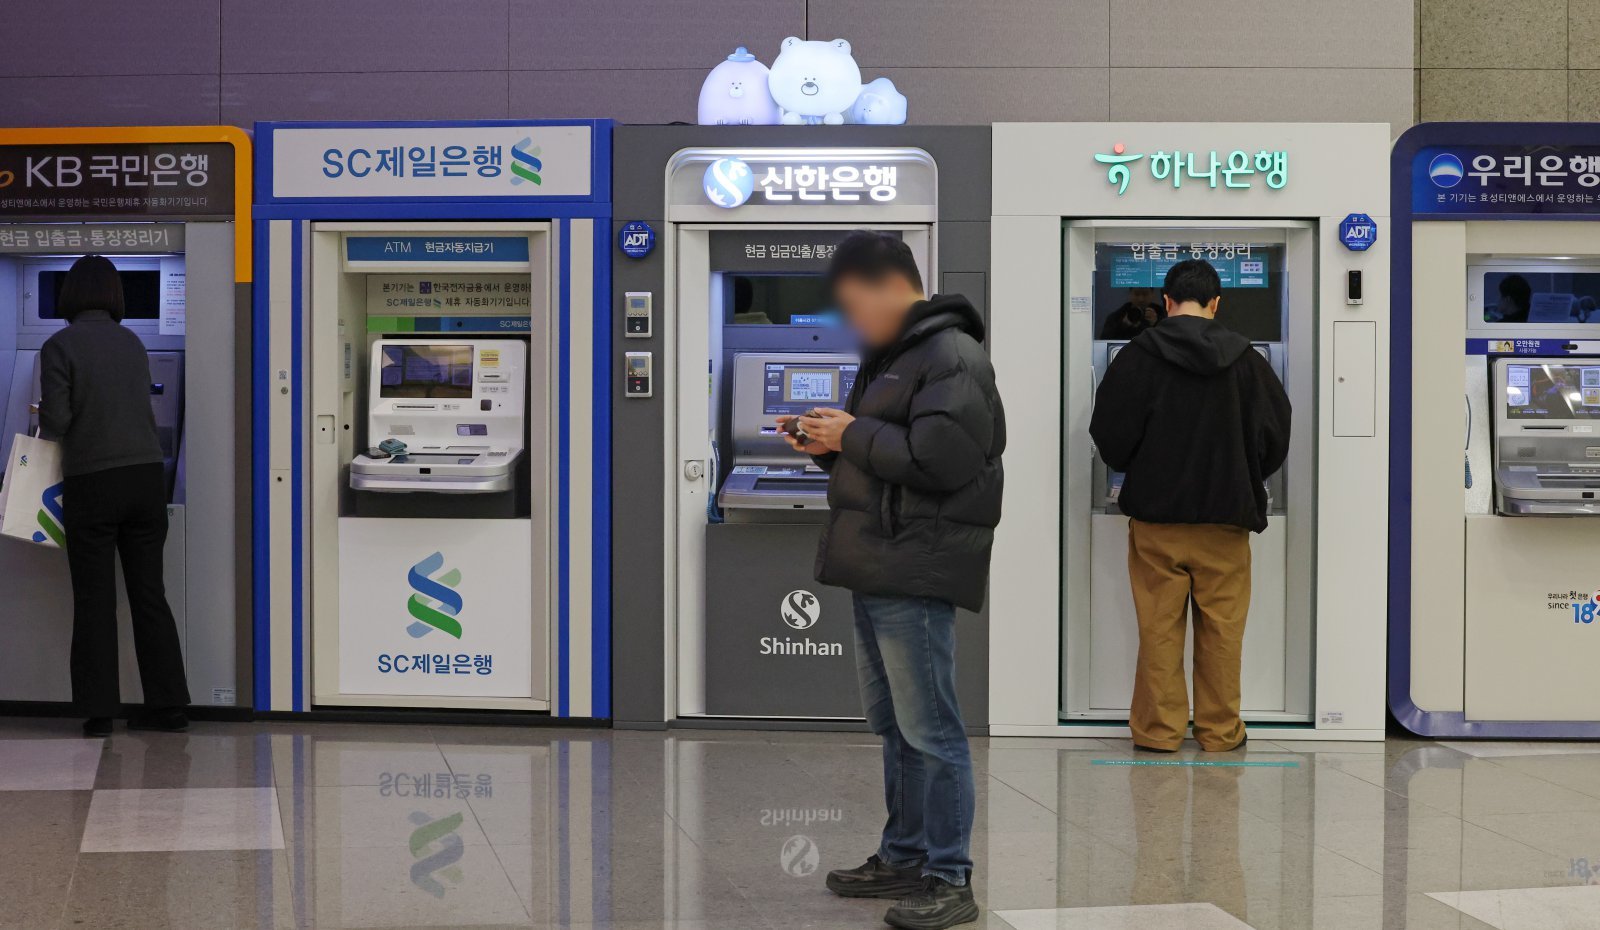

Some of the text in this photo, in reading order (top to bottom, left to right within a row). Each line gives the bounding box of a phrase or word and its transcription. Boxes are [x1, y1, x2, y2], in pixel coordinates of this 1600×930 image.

[322, 144, 502, 178] SC제일은행
[1150, 150, 1288, 189] 하나은행
[1467, 154, 1600, 187] 우리은행
[760, 164, 897, 202] 신한은행
[58, 198, 89, 208] 운영하는
[143, 197, 207, 207] 자동화기기입니다
[1437, 193, 1446, 203] 본
[1450, 193, 1477, 203] 기기는
[1479, 193, 1554, 203] 효성티앤에스에서
[1557, 193, 1593, 203] 운영하는
[0, 229, 29, 247] 현금
[1346, 225, 1371, 239] ADT
[625, 233, 648, 246] ADT
[384, 241, 494, 254] ATM 현금자동지급기
[745, 244, 766, 259] 현금
[382, 282, 415, 293] 본기기는
[433, 282, 500, 293] 한국전자금융에서
[504, 282, 531, 293] 운영하
[386, 298, 432, 307] SC제일은행
[445, 297, 461, 307] 제휴
[499, 320, 531, 328] SC제일은
[1547, 602, 1569, 610] since
[760, 637, 843, 656] Shinhan
[377, 653, 493, 675] SC제일은행
